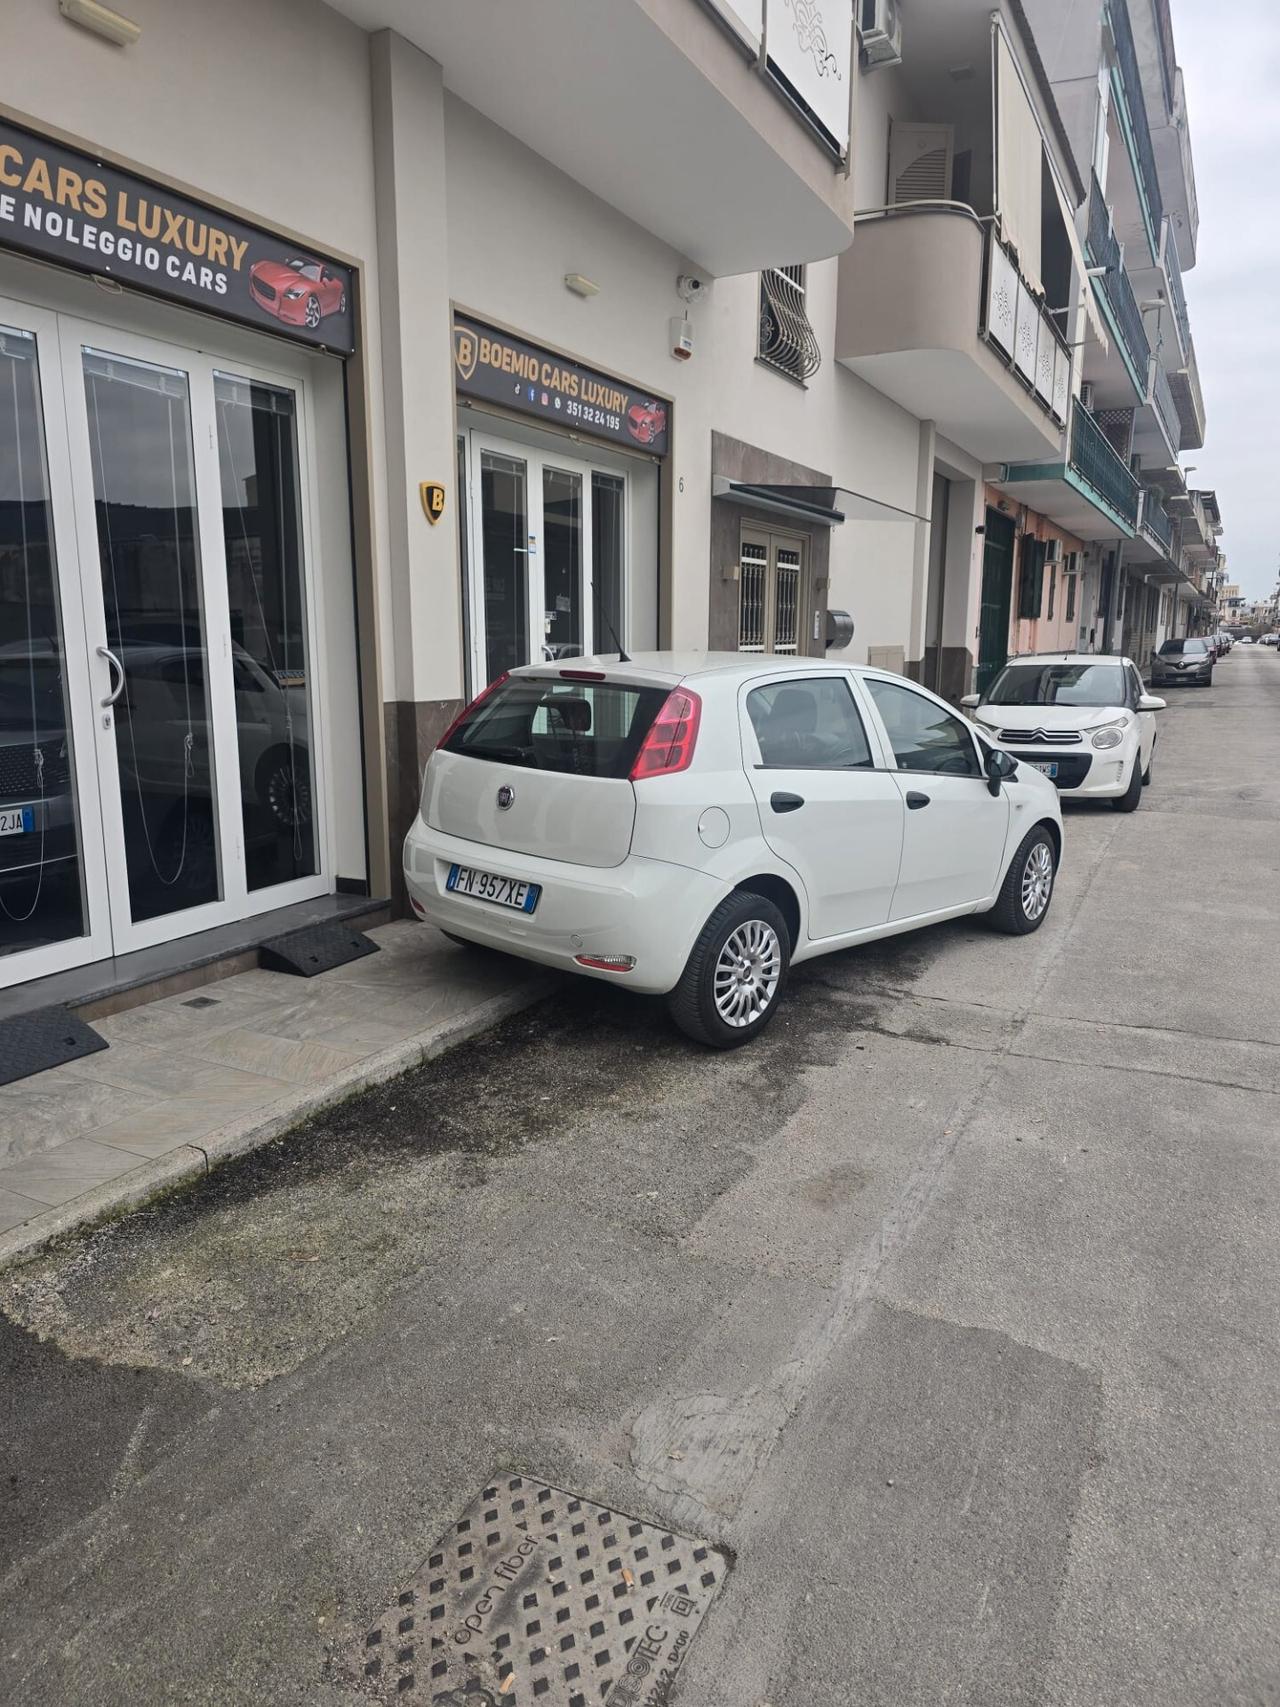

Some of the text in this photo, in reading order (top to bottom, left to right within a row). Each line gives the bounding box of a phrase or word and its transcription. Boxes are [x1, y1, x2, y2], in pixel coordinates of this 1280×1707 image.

[0, 143, 249, 272] CARS LUXURY
[0, 193, 229, 296] E NOLEGGIO CARS
[459, 336, 629, 415] B BOEMIO CARS LUXURY
[566, 400, 620, 430] 351 32 24 195
[431, 488, 444, 512] B
[679, 477, 685, 493] 6
[455, 868, 477, 892] FN
[478, 873, 527, 905] 957XE
[453, 1534, 540, 1645] open fiber
[667, 1630, 690, 1665] D400
